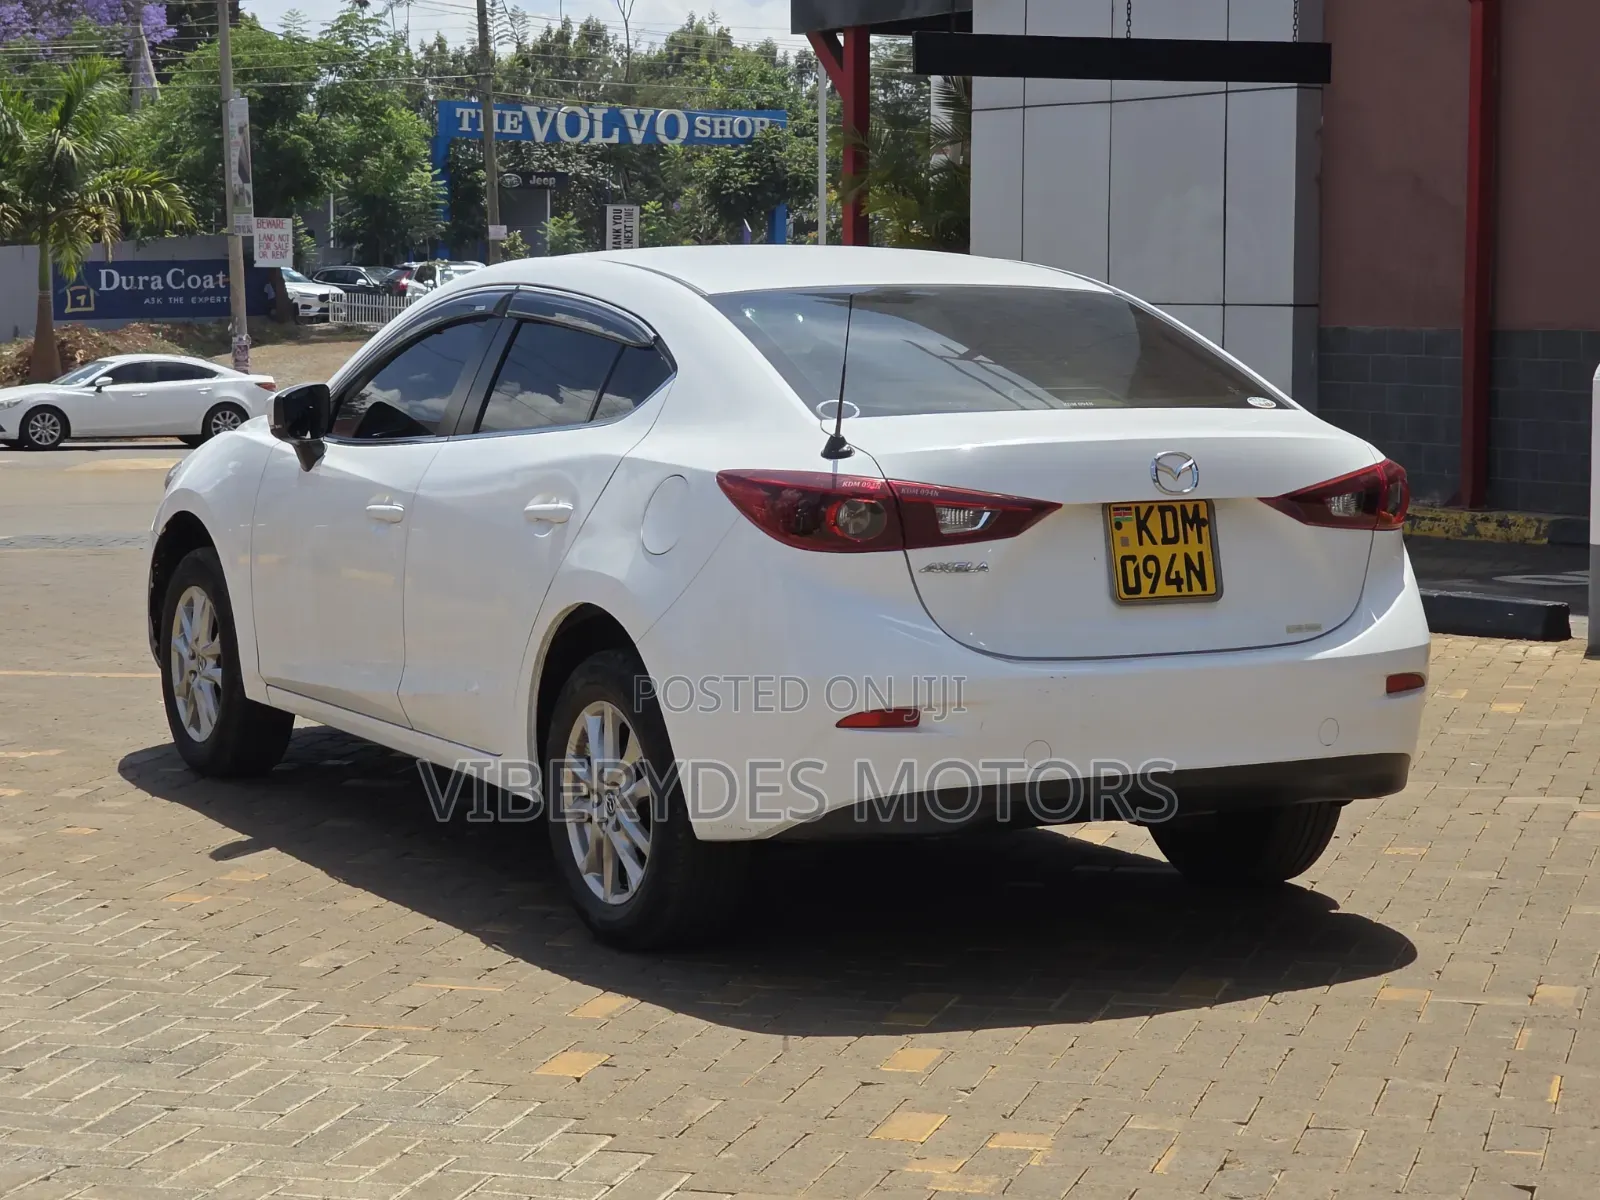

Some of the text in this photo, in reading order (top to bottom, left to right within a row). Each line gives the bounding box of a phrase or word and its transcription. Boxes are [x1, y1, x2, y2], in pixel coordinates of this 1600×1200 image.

[522, 105, 689, 144] VOLVO
[529, 175, 556, 187] Jeep
[624, 208, 634, 223] TIME
[256, 219, 286, 229] BEWARE
[612, 208, 623, 249] ANK YOU
[259, 233, 290, 242] LAND NOT
[624, 224, 633, 245] NEXT
[259, 242, 290, 250] FOR SALE
[259, 250, 289, 259] OR RENT
[191, 296, 232, 304] EXPERT
[842, 480, 860, 488] KDM
[901, 487, 918, 495] KDM
[1135, 504, 1203, 547] KDM
[918, 561, 990, 574] AXELA
[1120, 551, 1207, 595] 094N
